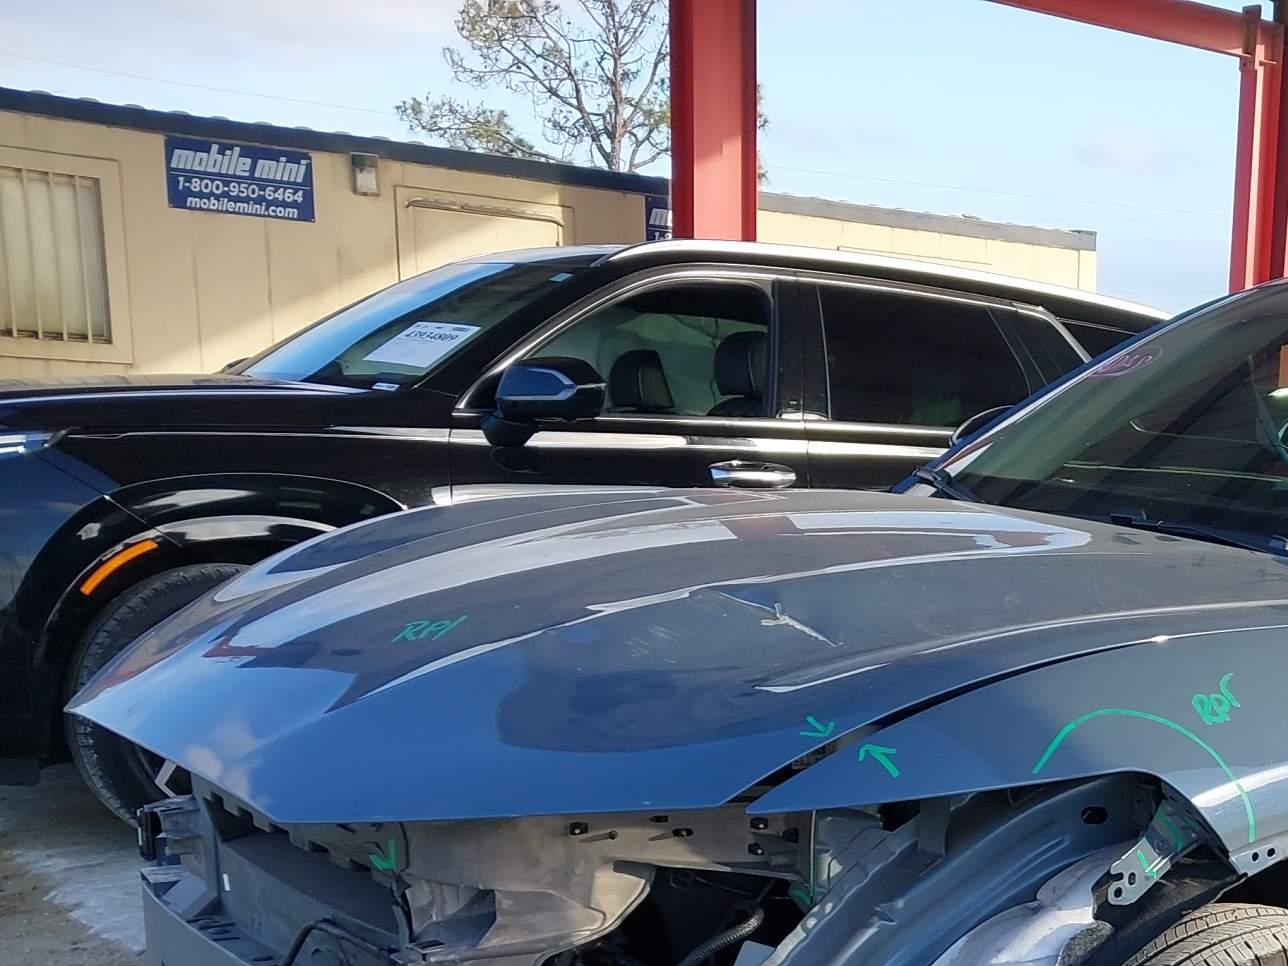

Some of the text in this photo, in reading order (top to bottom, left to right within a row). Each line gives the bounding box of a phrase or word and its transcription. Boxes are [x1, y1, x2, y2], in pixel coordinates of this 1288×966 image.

[170, 144, 307, 183] mobile mini
[177, 176, 304, 203] 1-800-950-6464
[186, 196, 299, 219] mobilemini.com
